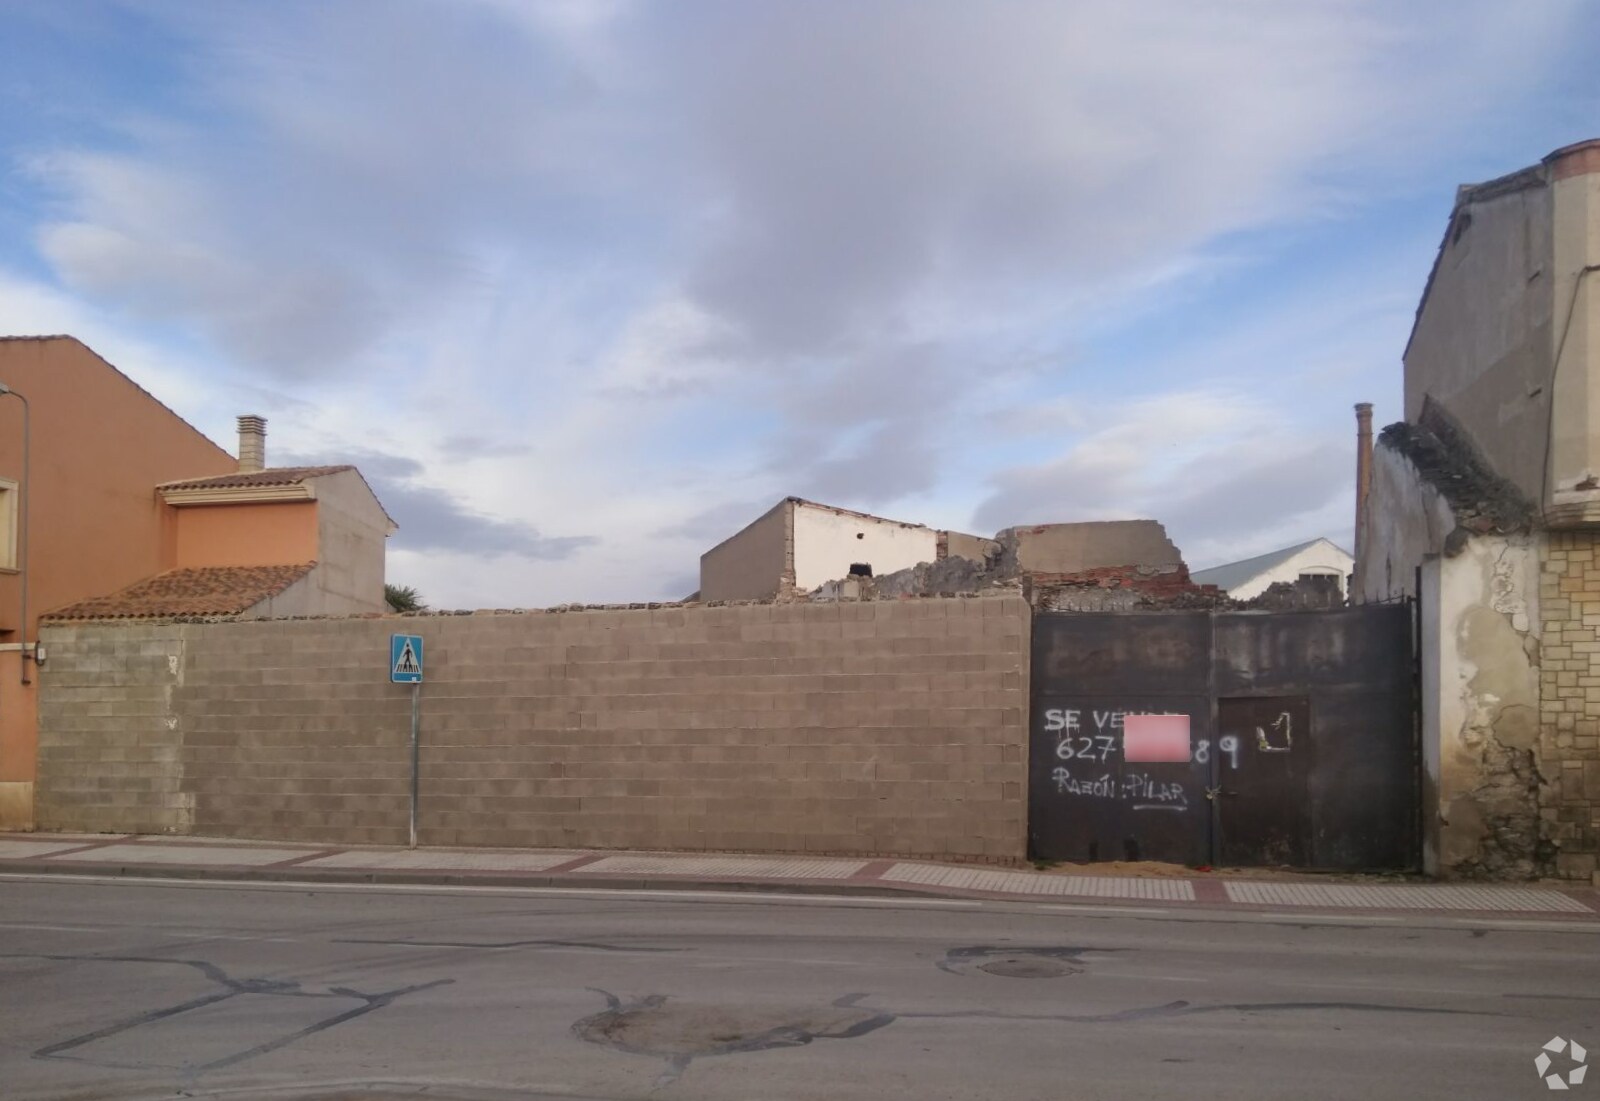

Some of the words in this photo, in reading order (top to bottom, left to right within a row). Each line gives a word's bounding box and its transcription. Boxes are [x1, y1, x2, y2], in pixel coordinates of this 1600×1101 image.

[1044, 709, 1081, 731] SE
[1056, 735, 1116, 761] 627
[1189, 736, 1238, 769] 89
